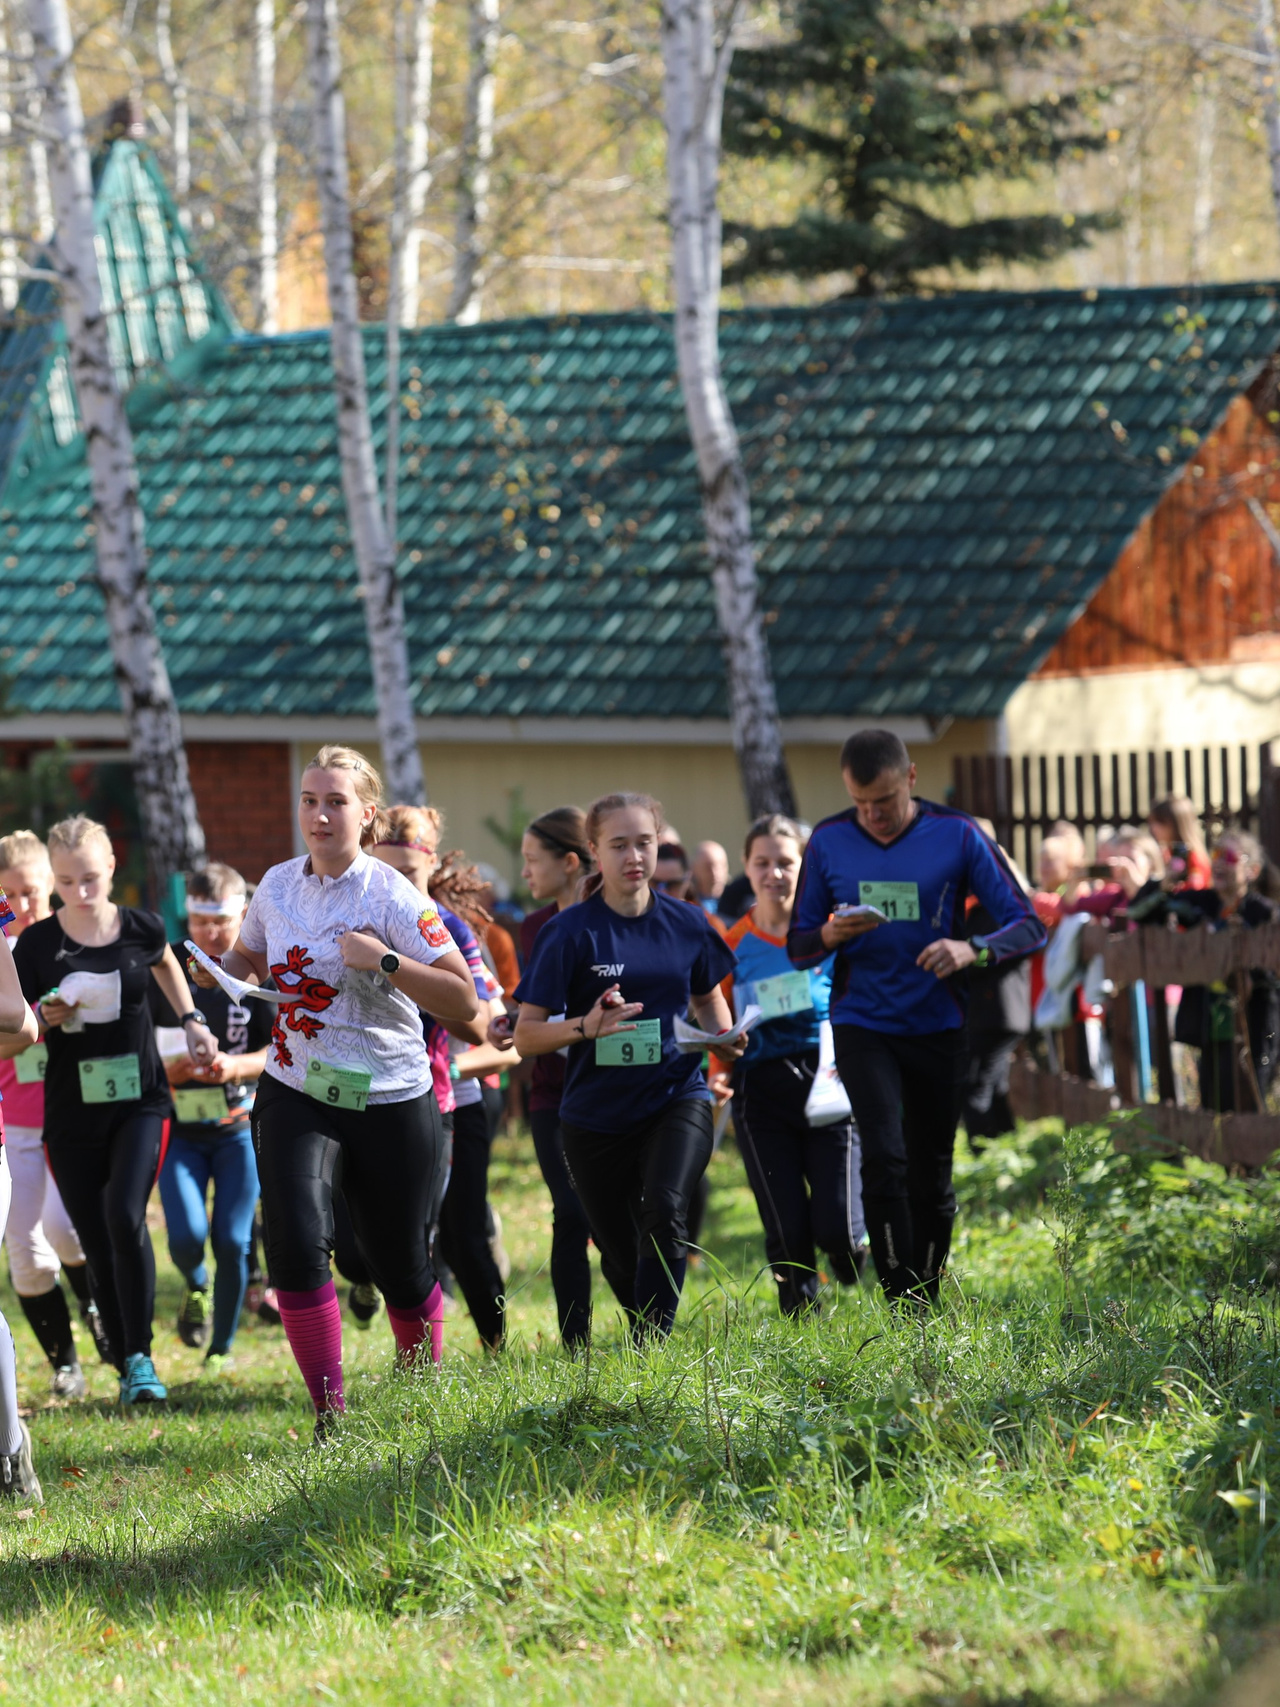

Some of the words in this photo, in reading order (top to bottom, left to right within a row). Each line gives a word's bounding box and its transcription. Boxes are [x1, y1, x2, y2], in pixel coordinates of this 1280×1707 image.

[881, 900, 898, 918] 11
[621, 1042, 634, 1063] 9
[648, 1047, 655, 1062] 2
[105, 1079, 117, 1099] 3
[326, 1085, 340, 1104] 9
[356, 1095, 362, 1109] 1
